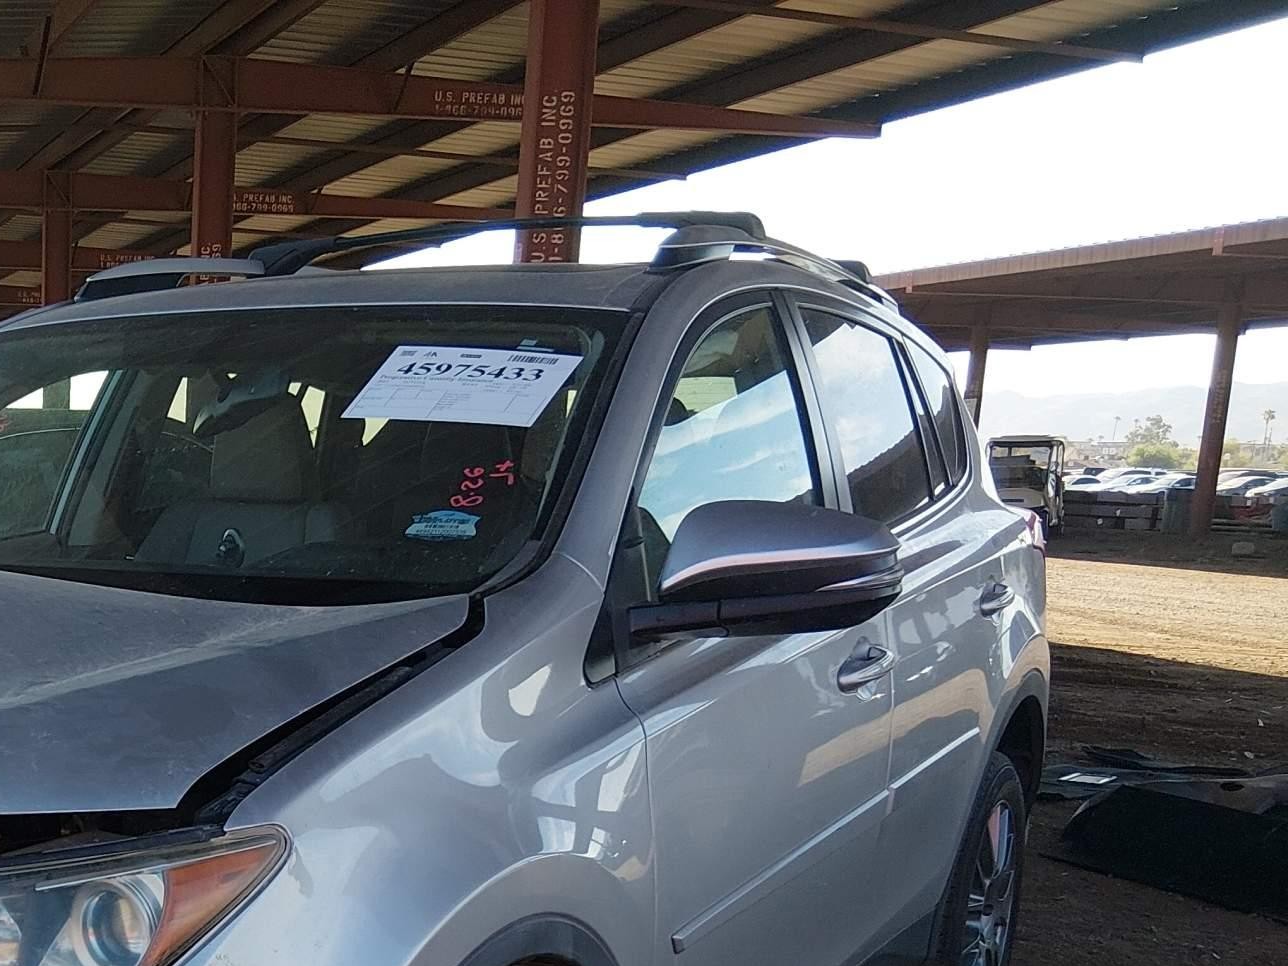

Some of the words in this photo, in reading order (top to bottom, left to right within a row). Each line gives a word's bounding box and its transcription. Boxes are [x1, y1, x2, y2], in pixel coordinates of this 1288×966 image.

[435, 91, 456, 103] U.S.
[462, 92, 506, 105] PREFAB
[534, 138, 555, 214] PREFAB
[549, 91, 576, 262] 1-86-799-0969
[243, 193, 276, 204] PREFAB
[397, 361, 545, 382] 45975433
